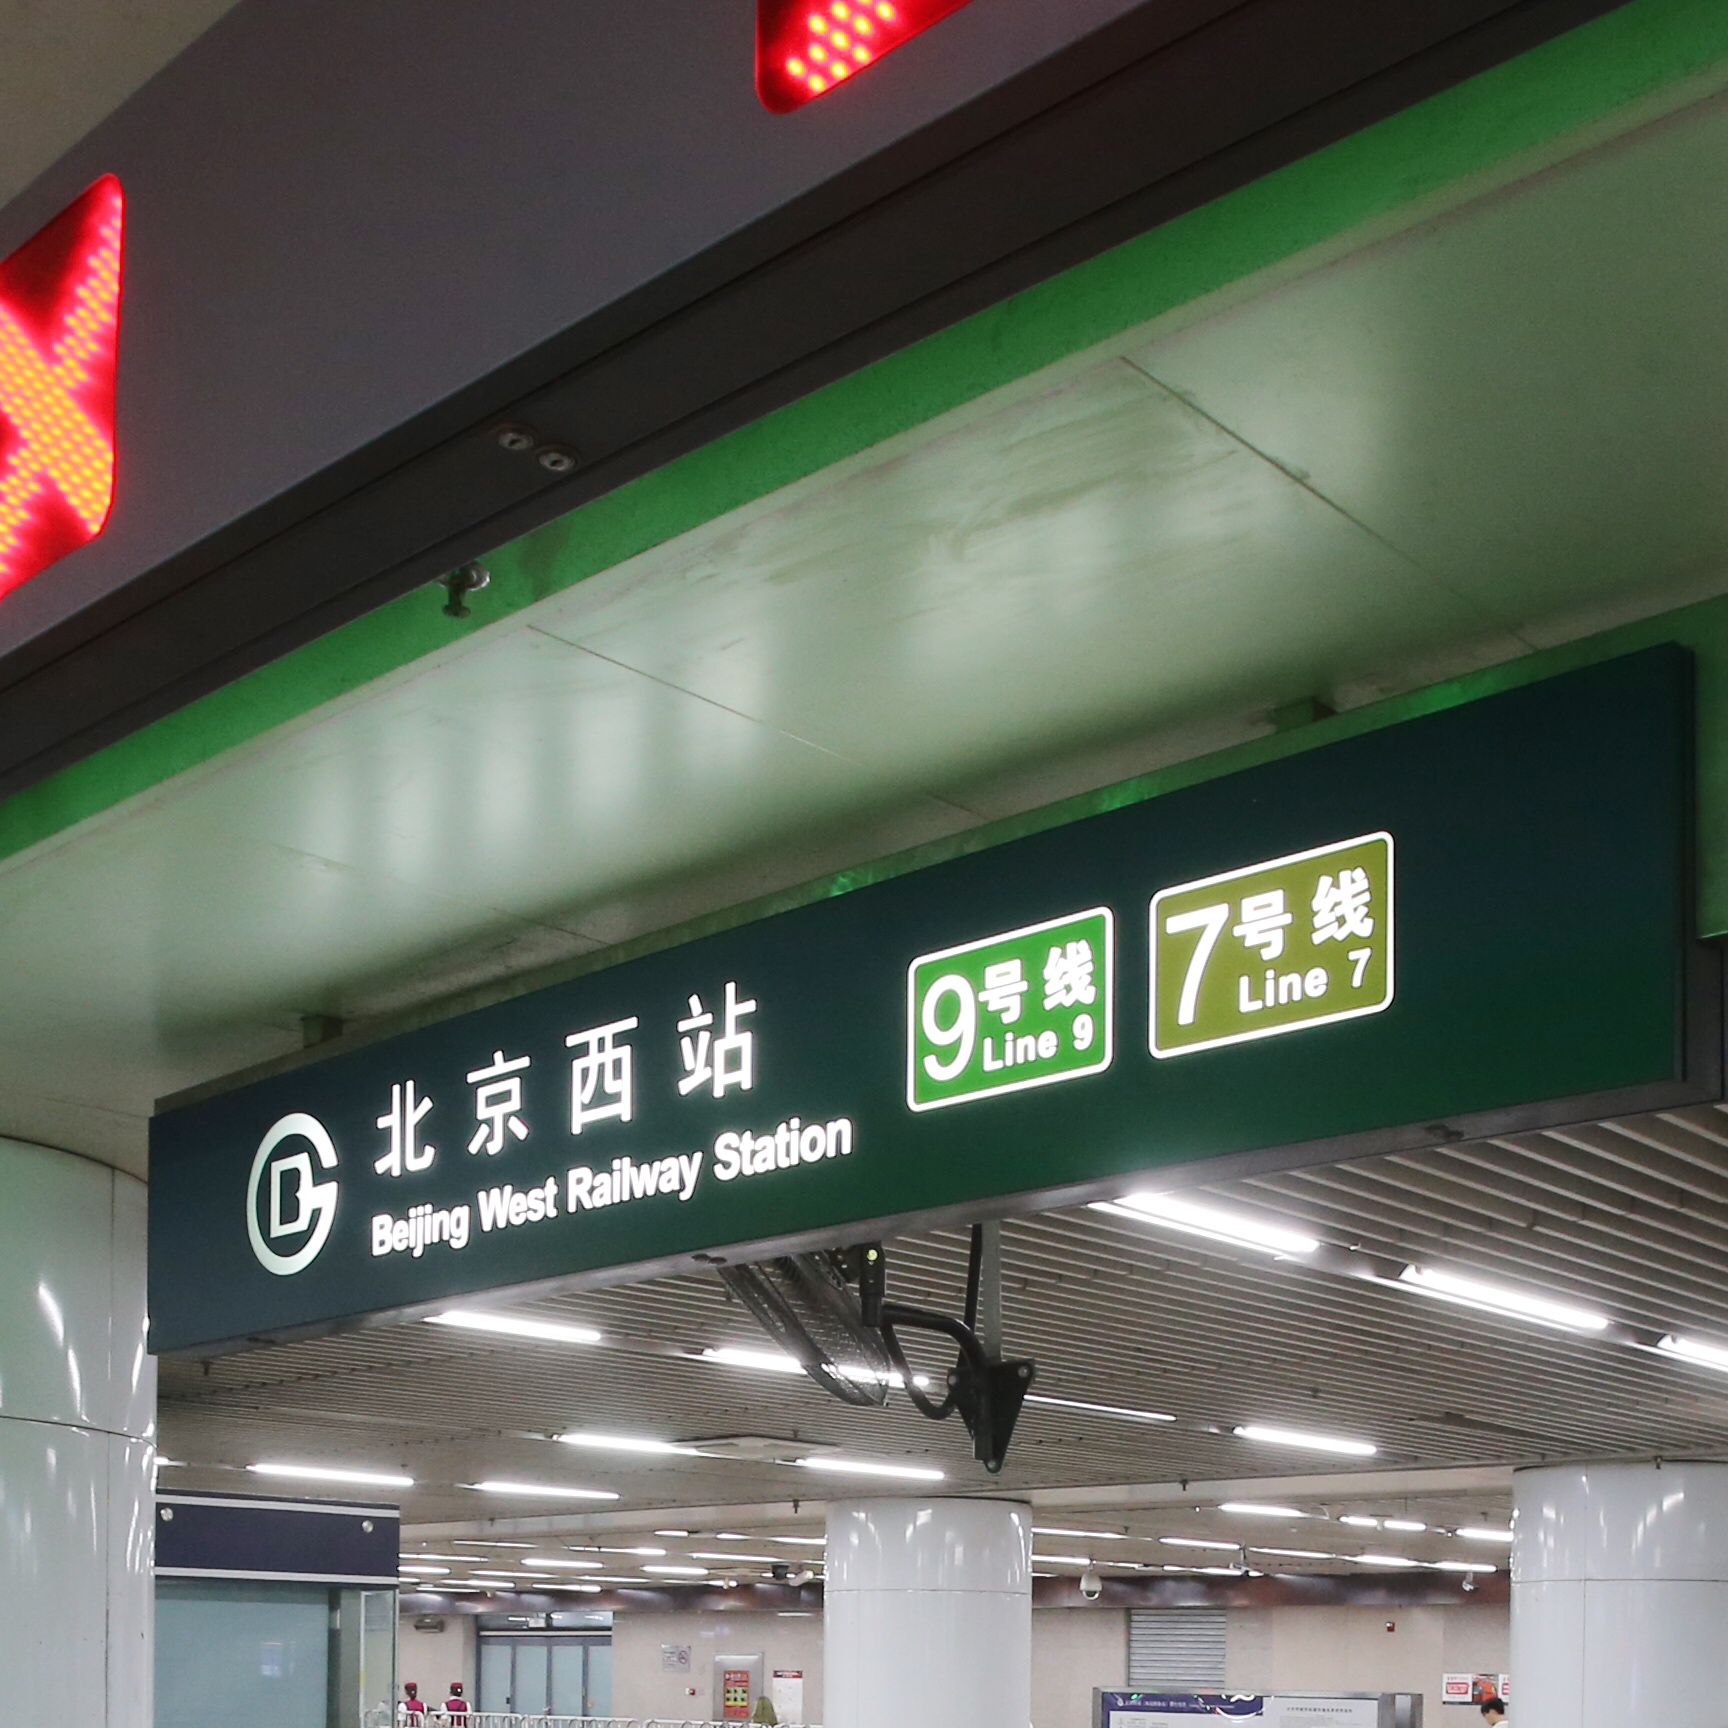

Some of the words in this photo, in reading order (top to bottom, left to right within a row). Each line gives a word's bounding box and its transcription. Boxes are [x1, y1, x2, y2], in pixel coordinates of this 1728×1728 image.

[921, 939, 1098, 1082] 9号线
[1165, 866, 1375, 1027] 7号线
[1238, 965, 1329, 1014] Line
[1348, 948, 1373, 988] 7
[374, 981, 757, 1178] 北京西站
[983, 1030, 1059, 1072] Line
[1072, 1013, 1096, 1051] 9
[370, 1203, 470, 1258] Beijing
[477, 1176, 558, 1233] West
[566, 1149, 703, 1214] Railway
[712, 1116, 854, 1182] Station
